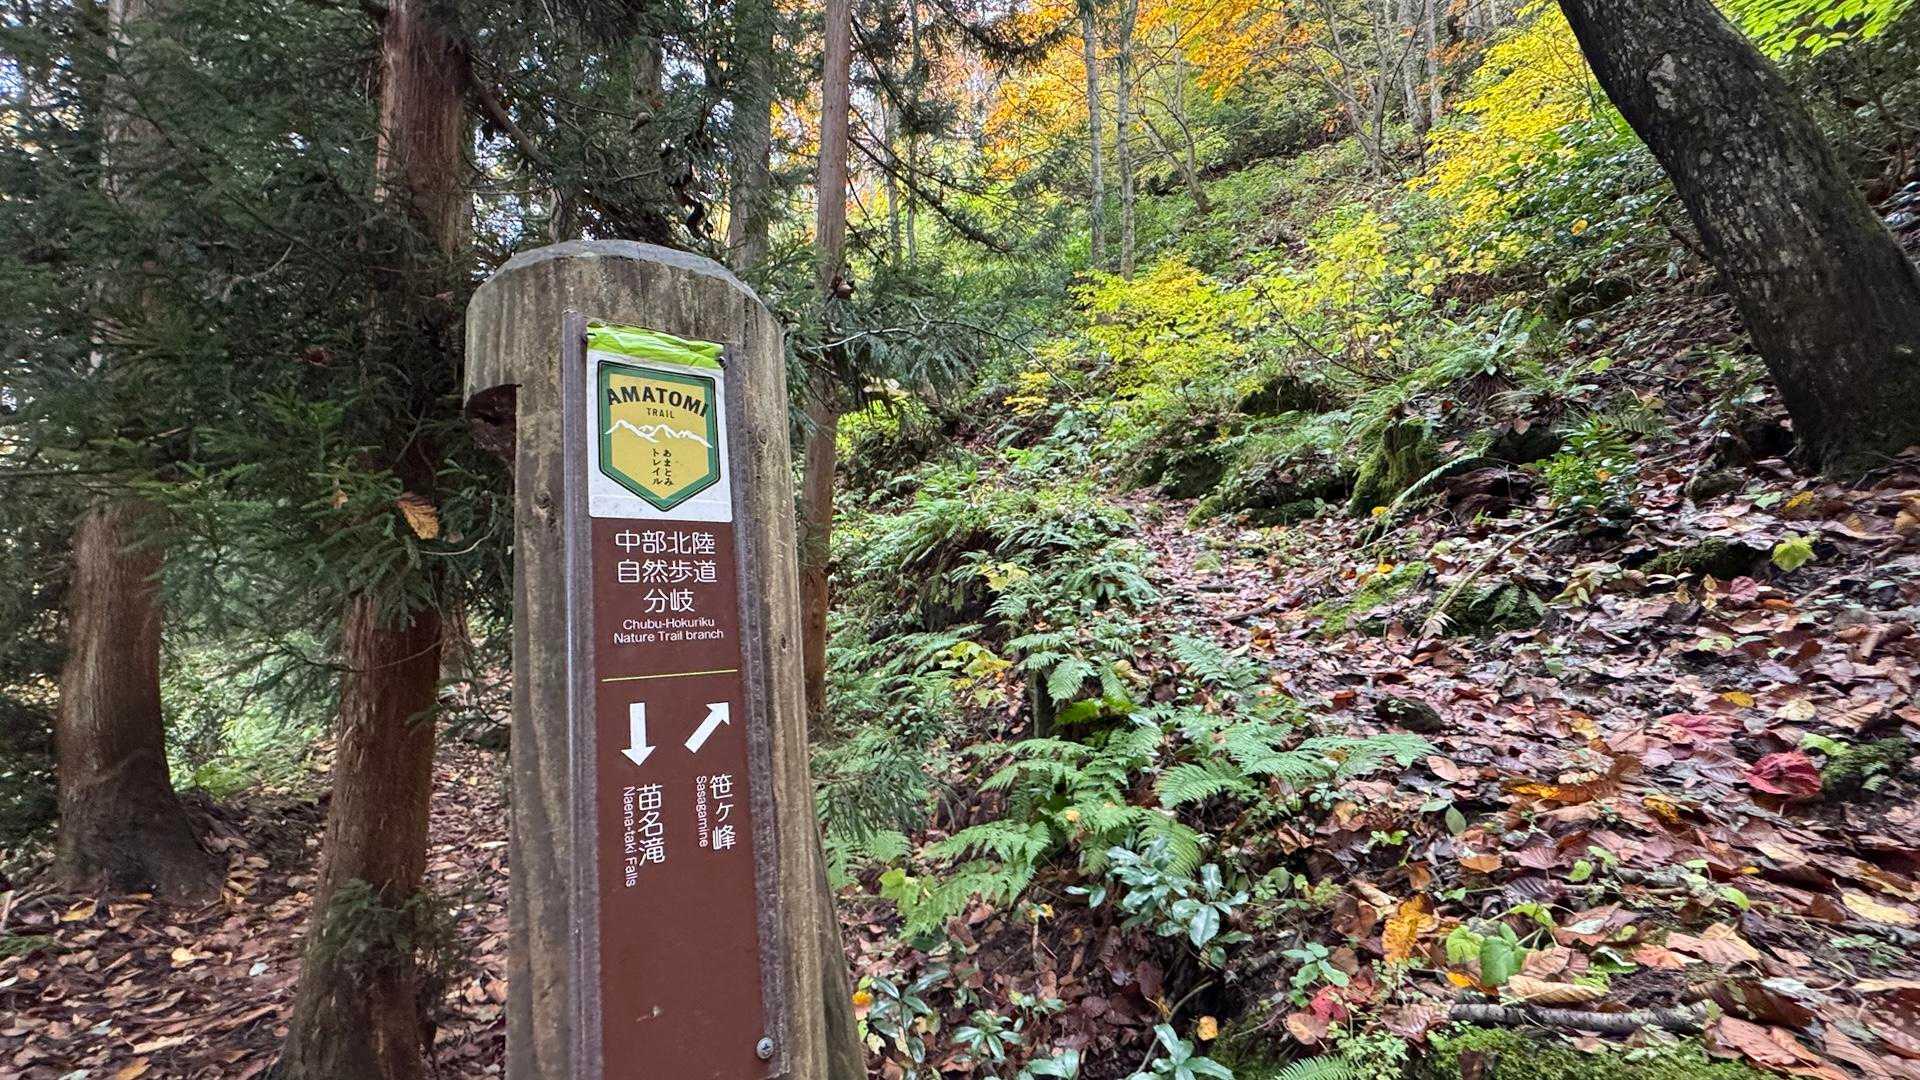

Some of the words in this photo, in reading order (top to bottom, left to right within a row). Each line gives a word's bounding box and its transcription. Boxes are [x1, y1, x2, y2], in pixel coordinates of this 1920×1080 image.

[607, 385, 708, 417] AMATOMI
[646, 407, 675, 419] TRAIL
[651, 448, 664, 485] トレイル
[663, 449, 674, 486] あまとみ
[615, 529, 716, 555] 中部北陸
[617, 558, 717, 583] 自然歩道
[643, 588, 696, 613] 分岐
[613, 631, 655, 644] Nature
[657, 630, 683, 642] Trail
[685, 628, 724, 640] branch
[622, 617, 715, 630] Chubu-Hokuriku
[623, 786, 637, 854] Naena-taki
[636, 783, 665, 866] 苗名滝
[696, 775, 710, 848] Sasagamine
[624, 857, 638, 888] Falls
